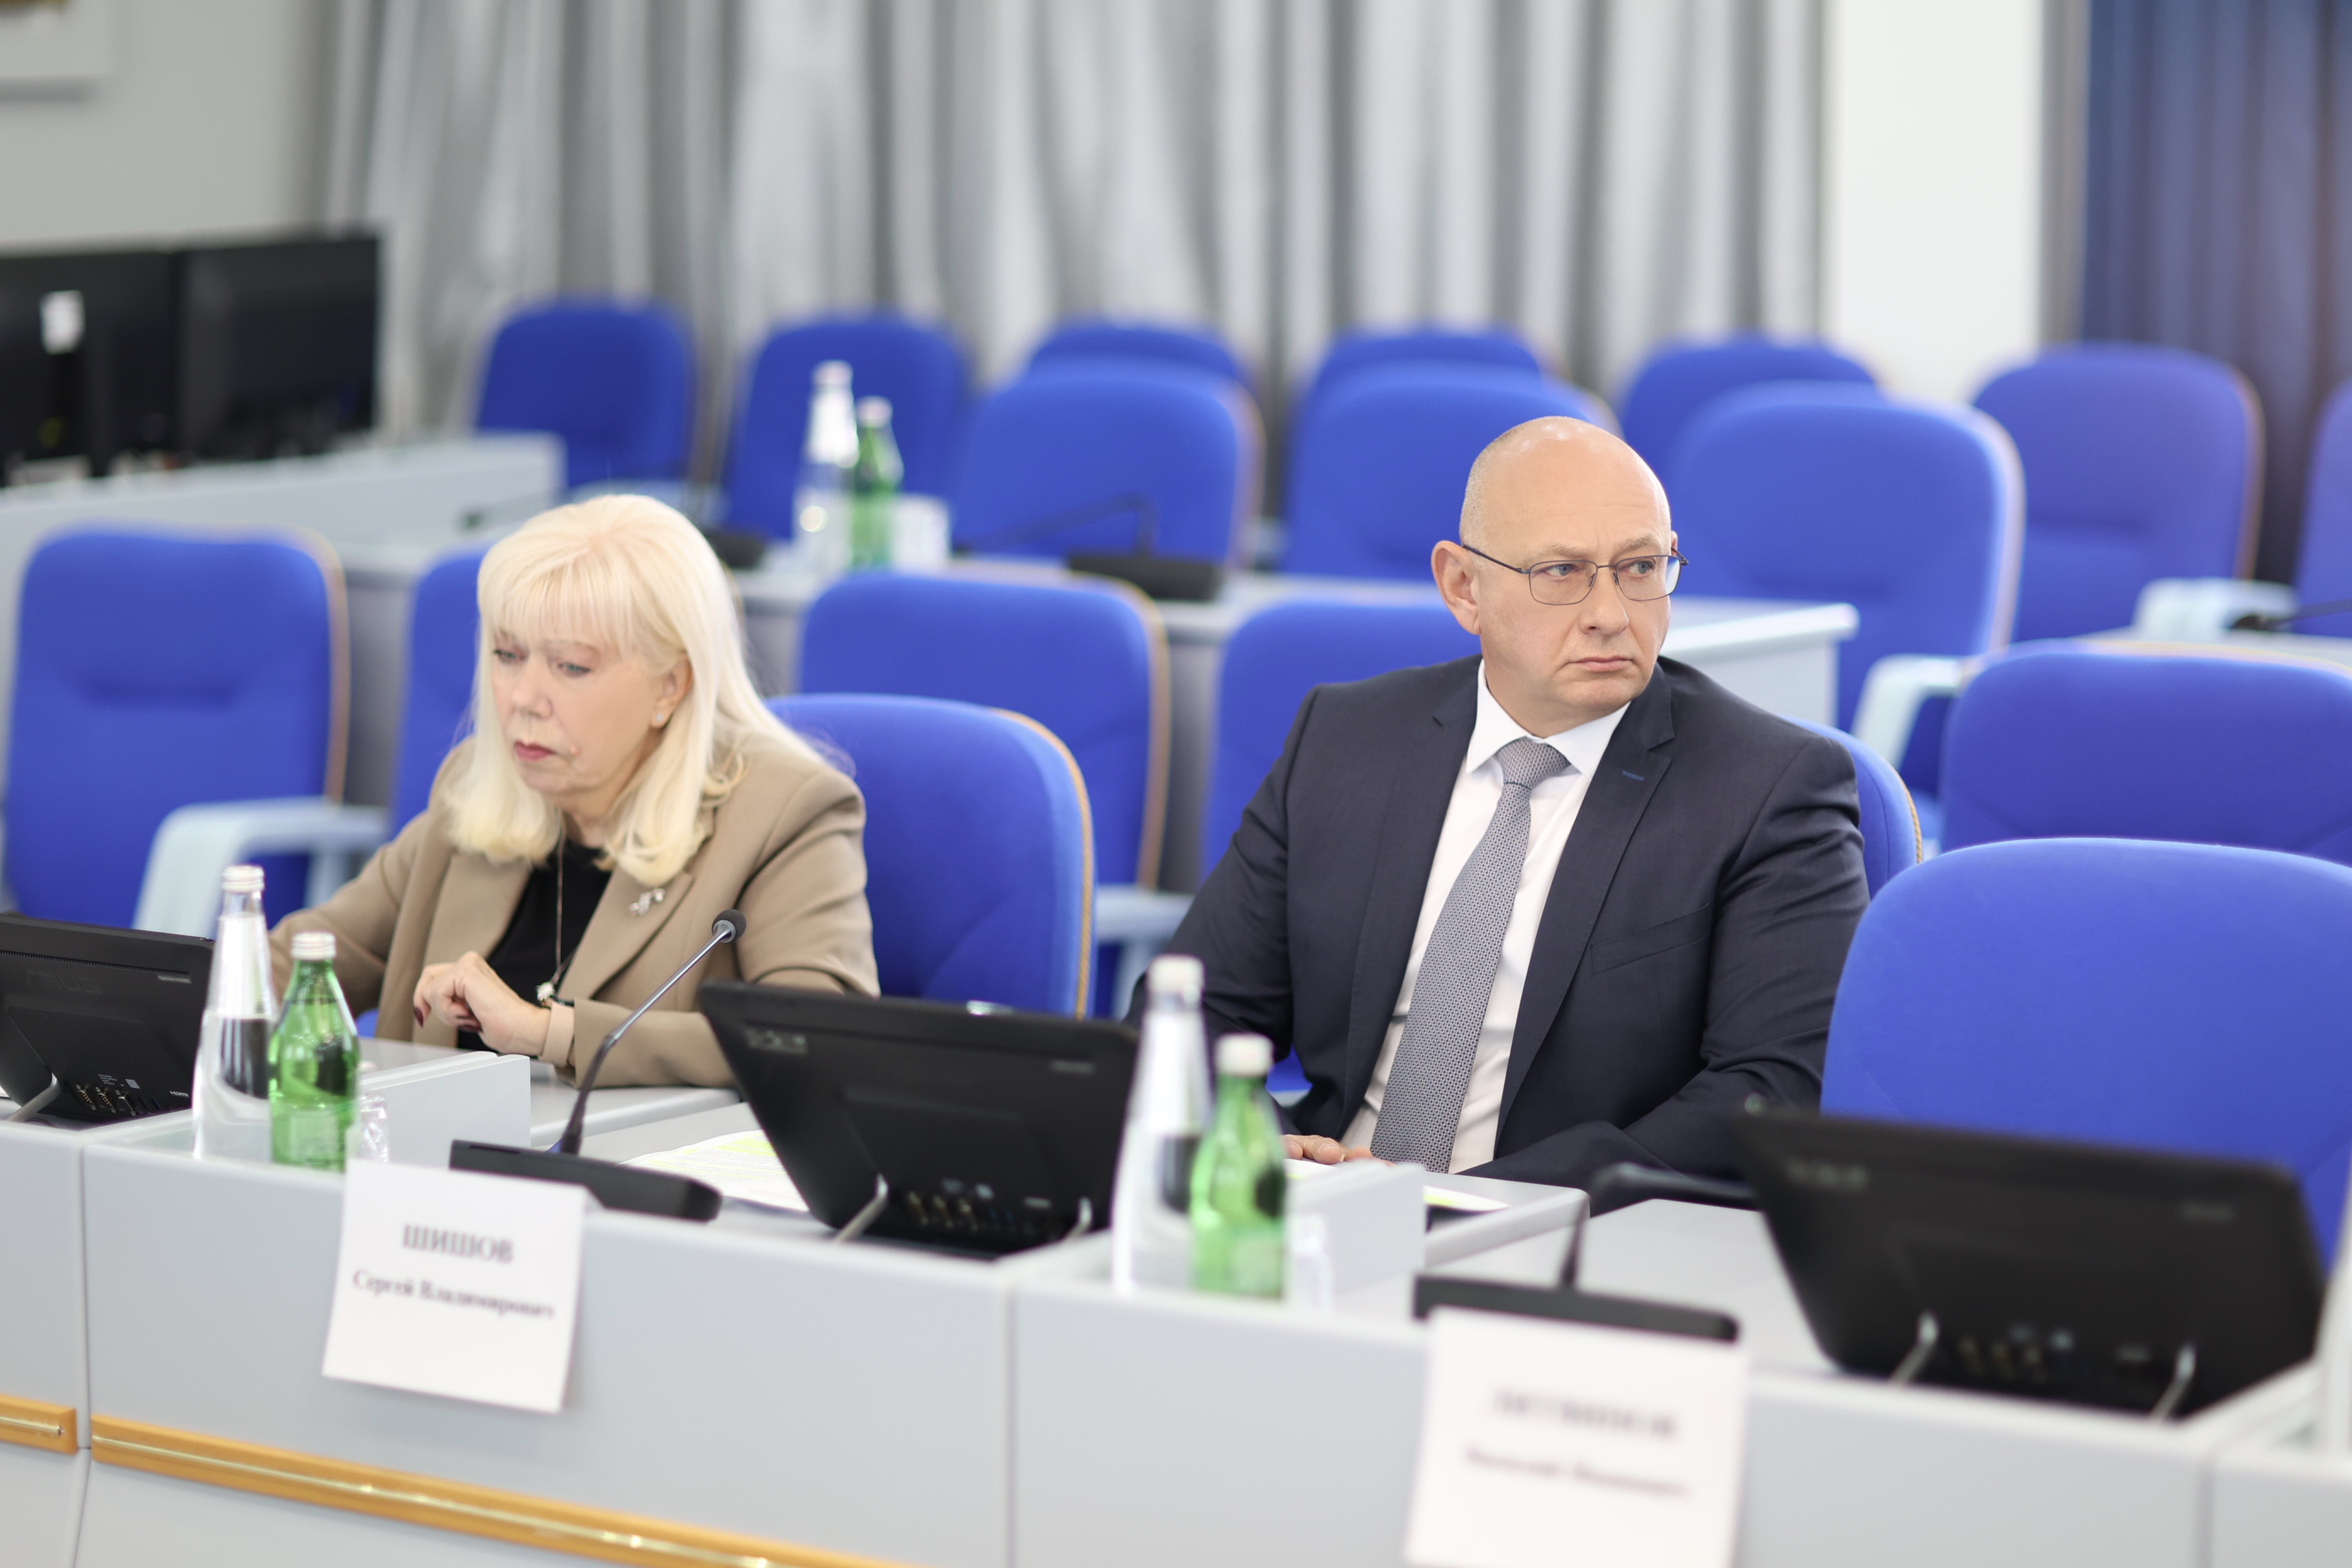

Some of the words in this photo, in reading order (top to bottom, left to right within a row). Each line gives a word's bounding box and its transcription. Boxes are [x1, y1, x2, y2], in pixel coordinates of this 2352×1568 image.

[24, 970, 103, 995] ASUS
[404, 1224, 513, 1263] ШИШОВ
[353, 1269, 413, 1297] Сергей
[420, 1280, 554, 1318] Владимирович
